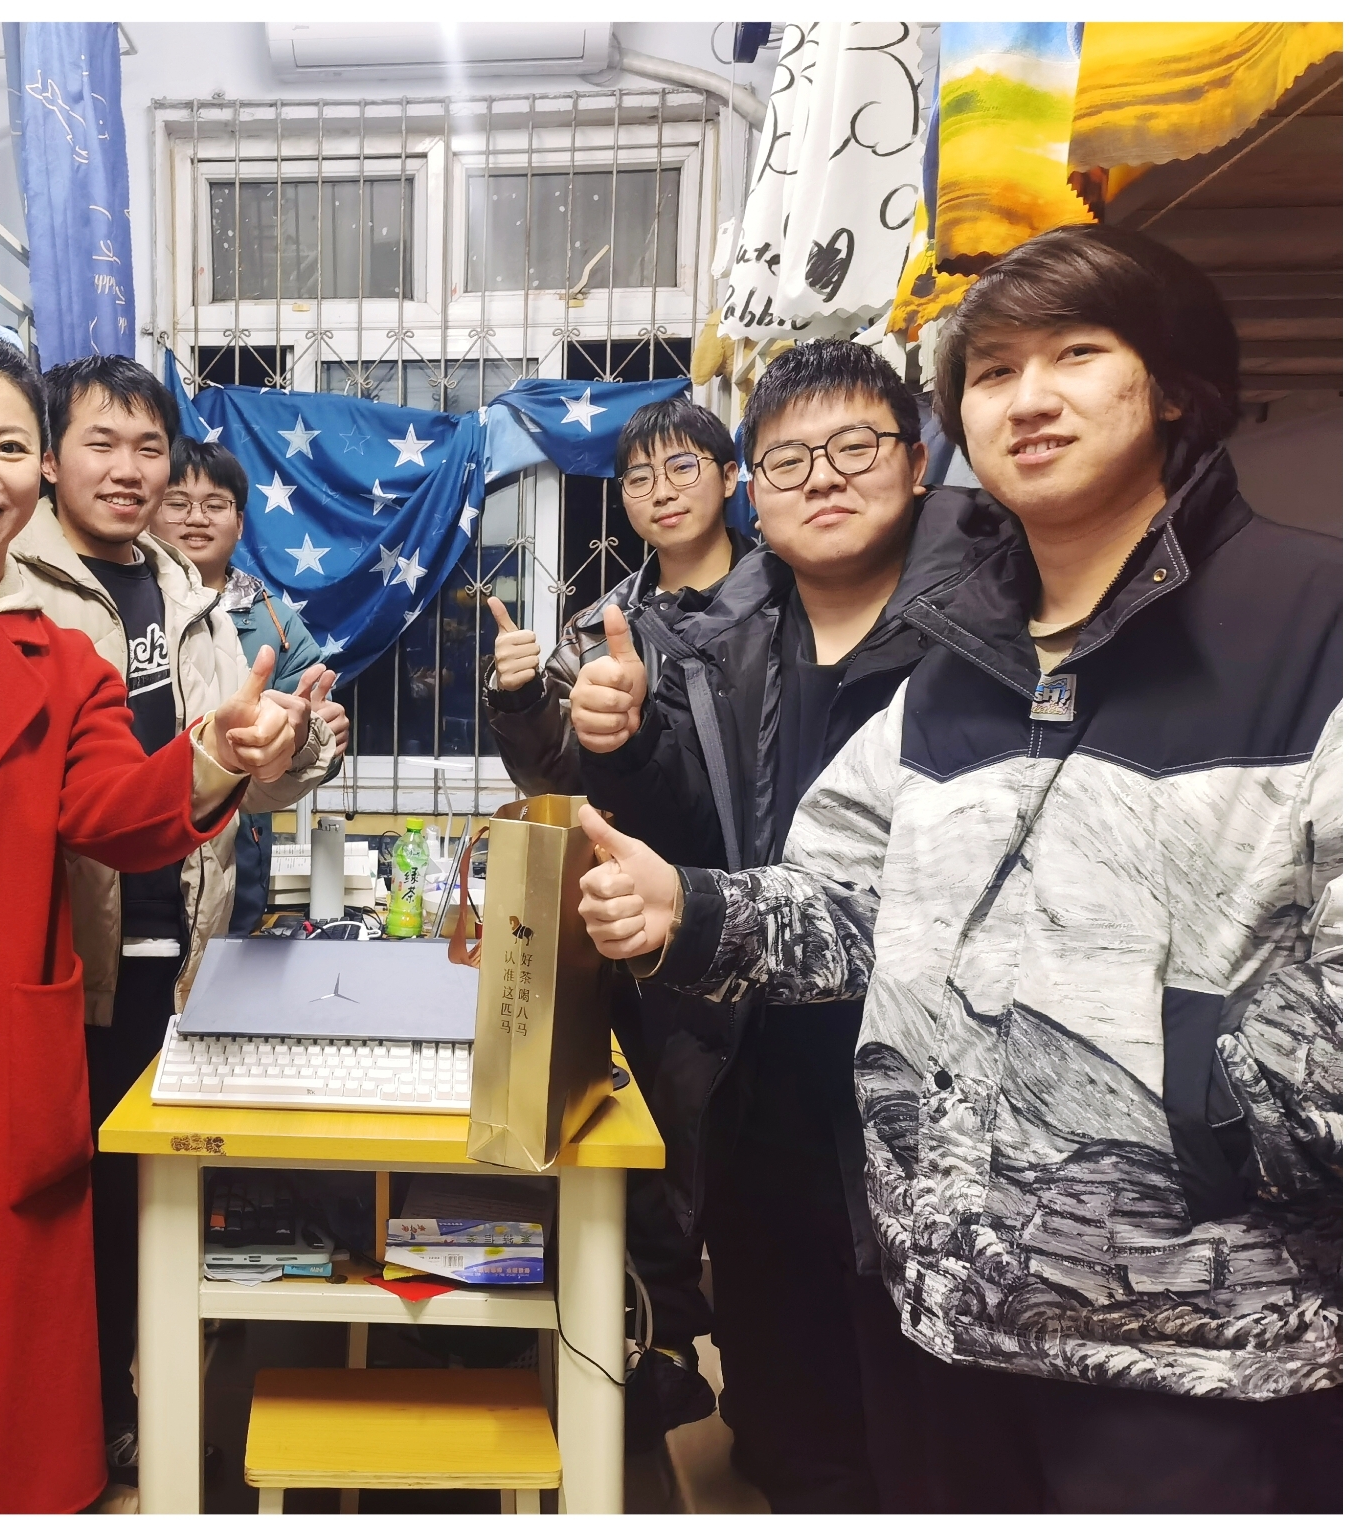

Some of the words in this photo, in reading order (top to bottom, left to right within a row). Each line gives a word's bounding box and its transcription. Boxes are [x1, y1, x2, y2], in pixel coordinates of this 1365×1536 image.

[401, 866, 419, 904] 绿茶
[500, 950, 516, 1034] 认准这匹马
[515, 952, 533, 1037] 好茶喝八马
